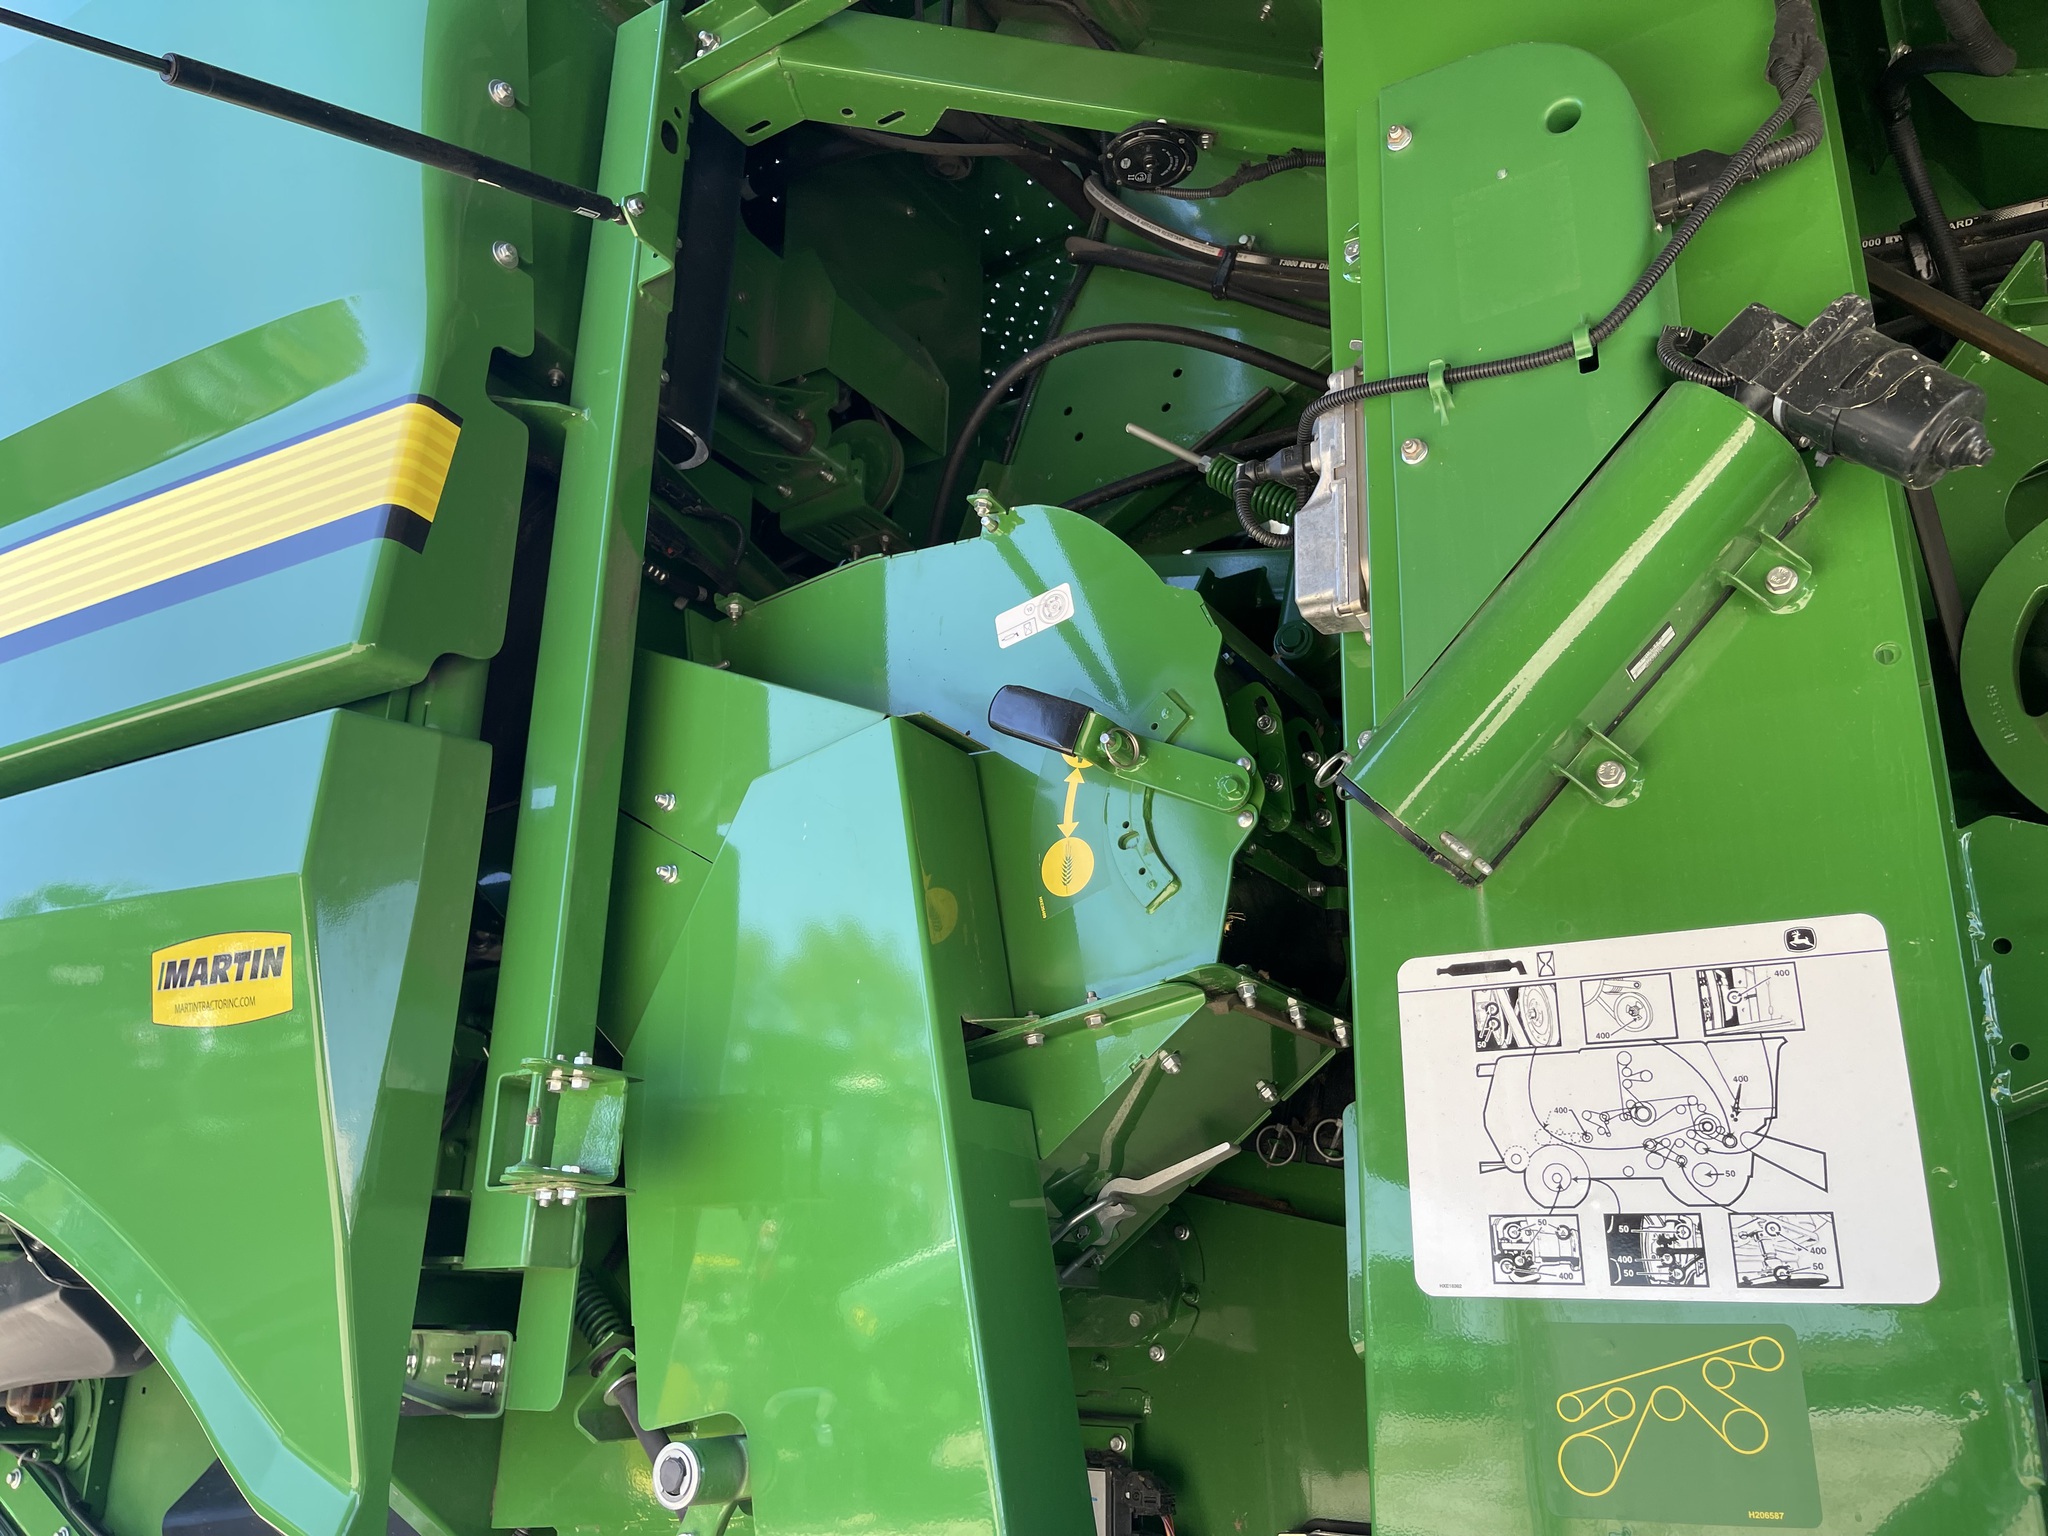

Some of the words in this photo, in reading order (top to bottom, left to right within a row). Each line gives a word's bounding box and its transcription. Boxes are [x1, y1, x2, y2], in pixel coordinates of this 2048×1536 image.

[163, 945, 286, 991] MARTIN
[1774, 969, 1790, 977] 400
[174, 996, 256, 1015] MARTINTRACTORINC.COM
[1595, 1031, 1611, 1040] 400
[1477, 1040, 1487, 1049] 50
[1732, 1075, 1749, 1083] 400
[1553, 1106, 1568, 1114] 400
[1725, 1169, 1736, 1178] 50
[1537, 1218, 1548, 1226] 50
[1618, 1224, 1629, 1233] 50
[1809, 1247, 1827, 1255] 400
[1617, 1255, 1633, 1264] 400
[1812, 1262, 1824, 1271] 50
[1558, 1272, 1574, 1280] 400
[1623, 1269, 1634, 1277] 50
[1748, 1510, 1785, 1520] H206587
